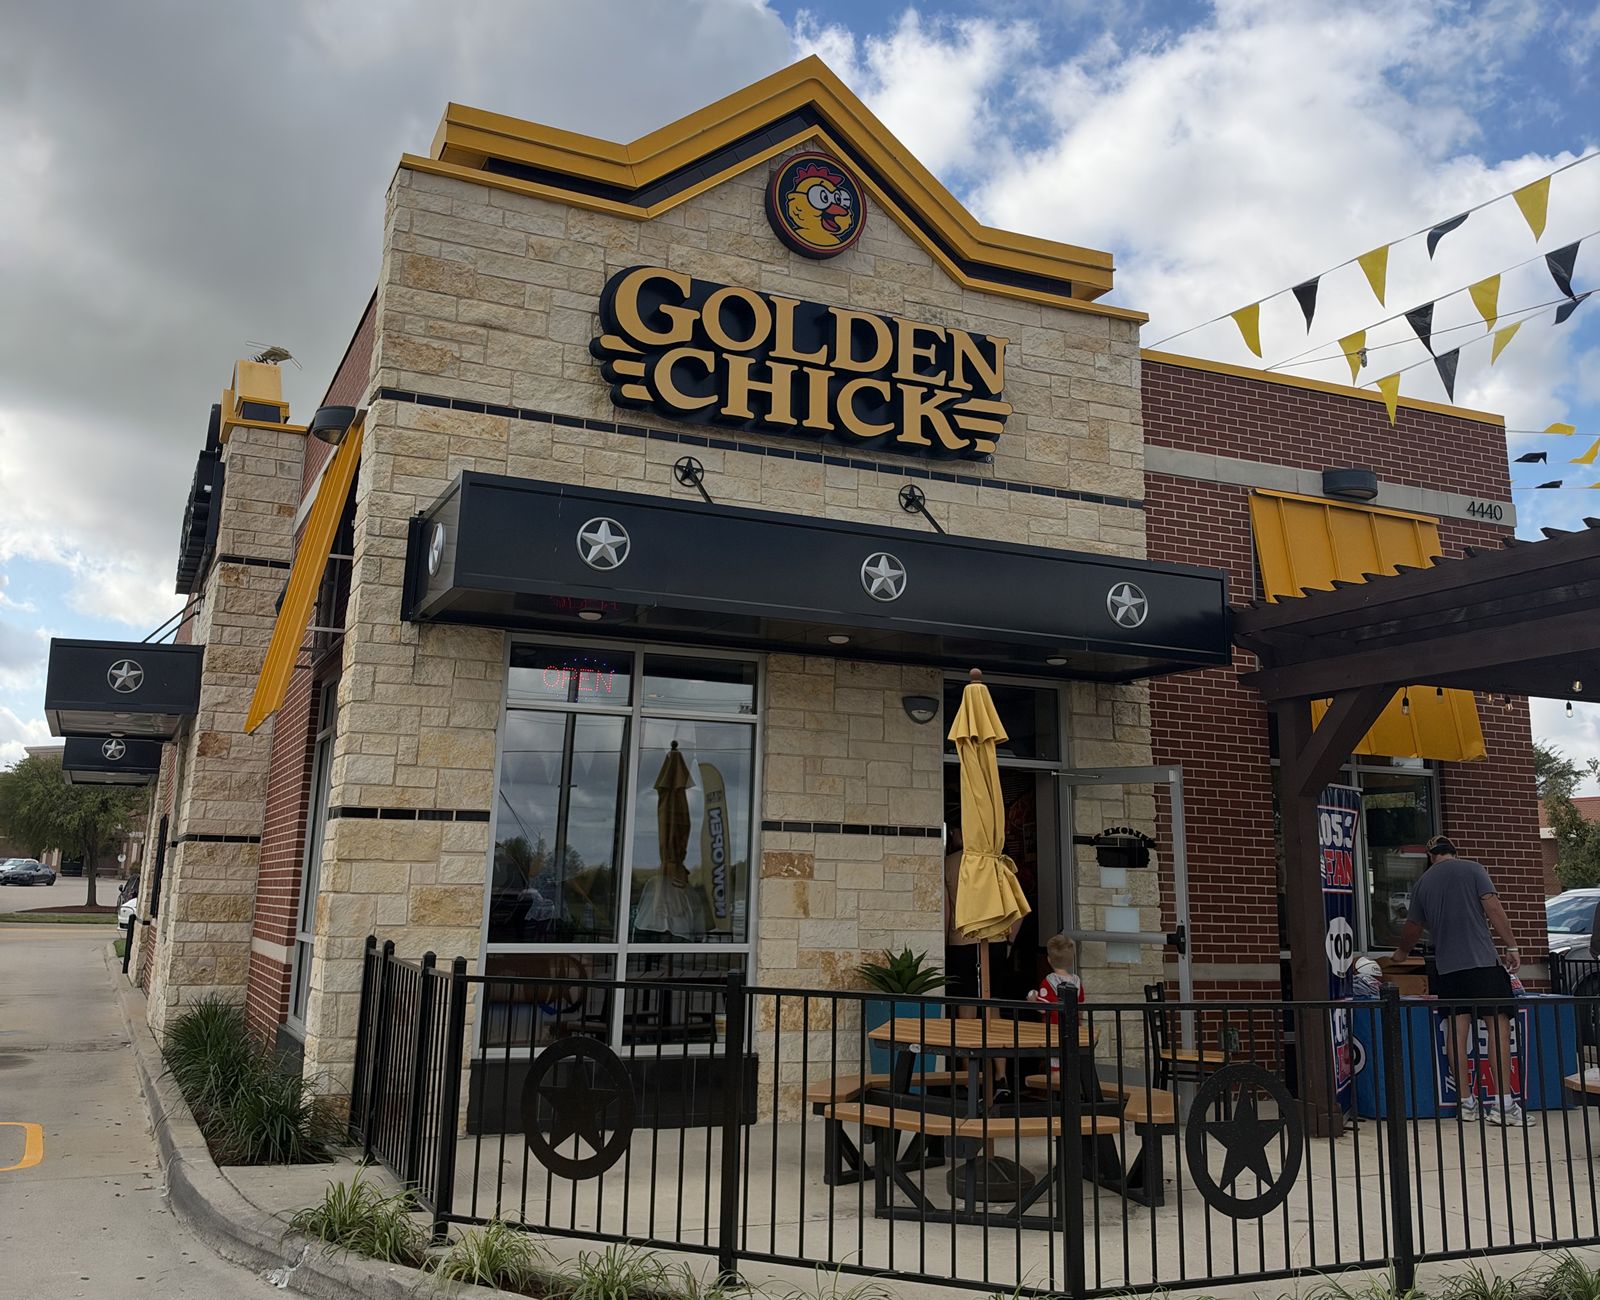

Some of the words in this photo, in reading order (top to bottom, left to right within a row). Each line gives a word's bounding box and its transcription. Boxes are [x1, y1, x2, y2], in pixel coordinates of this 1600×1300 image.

[614, 267, 1011, 396] GOLDEN
[654, 348, 970, 450] CHICK
[1466, 501, 1503, 520] 4440
[543, 665, 614, 694] OPEN
